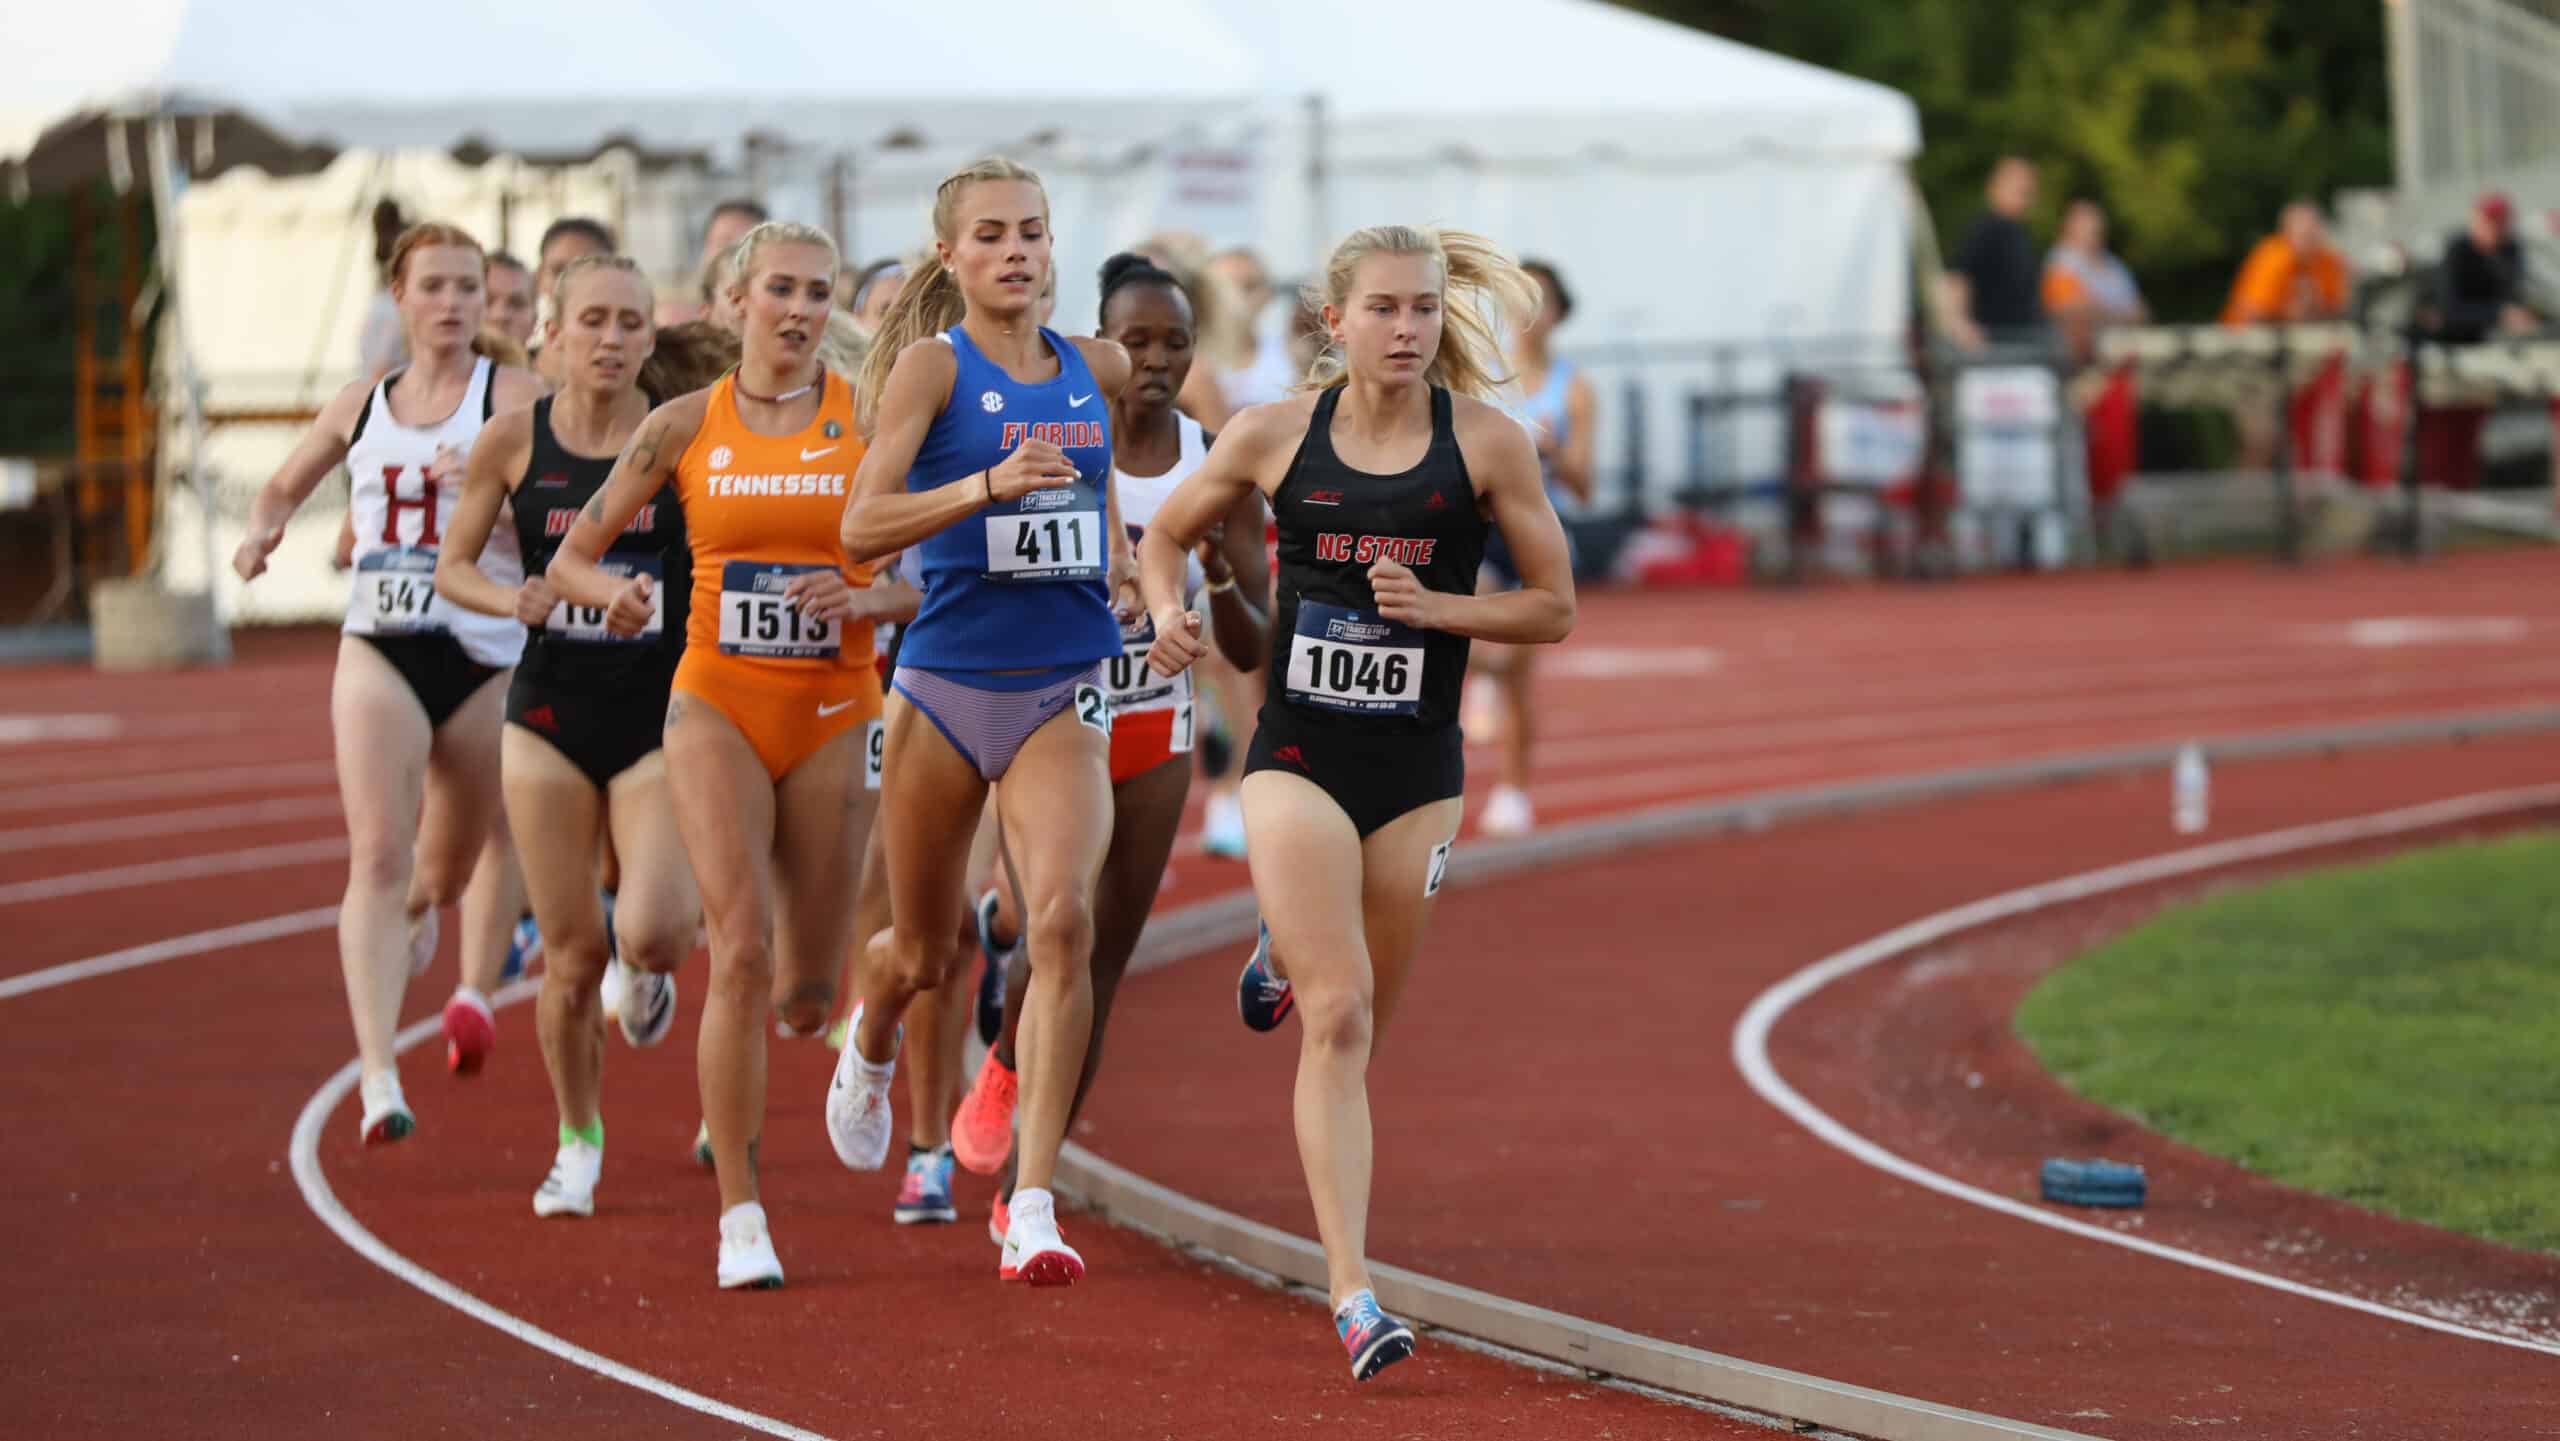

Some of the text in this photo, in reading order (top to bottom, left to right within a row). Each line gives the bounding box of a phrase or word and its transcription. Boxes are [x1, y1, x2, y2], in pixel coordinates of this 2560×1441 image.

[981, 391, 1004, 413] SEC
[1000, 421, 1104, 449] FLORIDA
[707, 474, 845, 497] TENNESSEE
[382, 466, 439, 545] H
[1015, 518, 1082, 564] 411
[1316, 533, 1436, 565] NC STATE
[378, 579, 435, 614] 547
[1109, 650, 1151, 690] 07
[1306, 645, 1409, 695] 1046
